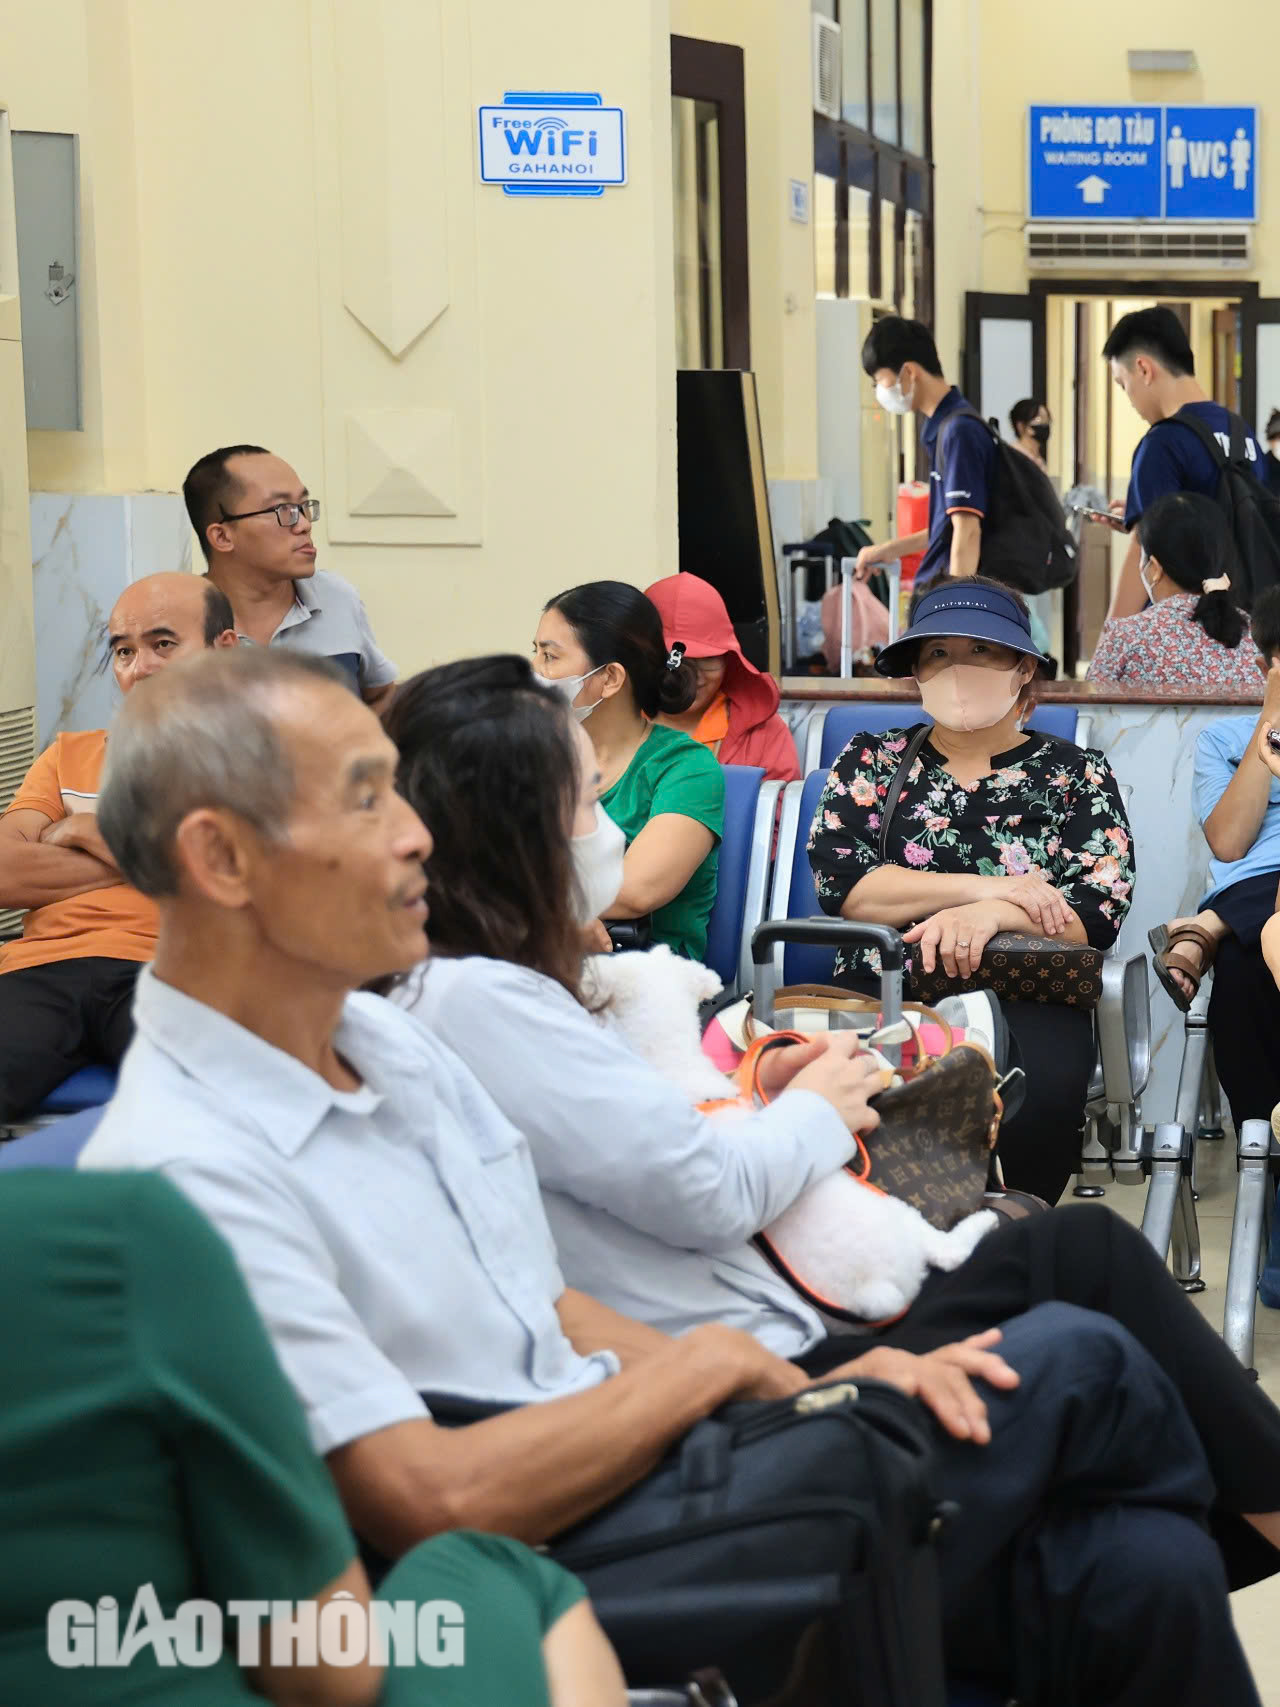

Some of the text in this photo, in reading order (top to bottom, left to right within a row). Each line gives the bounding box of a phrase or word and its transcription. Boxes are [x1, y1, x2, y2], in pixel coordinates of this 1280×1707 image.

[492, 117, 532, 129] Free
[1040, 111, 1155, 150] PHÒNG ĐỢI TÀU
[504, 129, 597, 156] WiFi
[508, 163, 593, 174] GAHANOI
[1044, 151, 1147, 166] WAITING ROOM
[1188, 141, 1227, 179] WC
